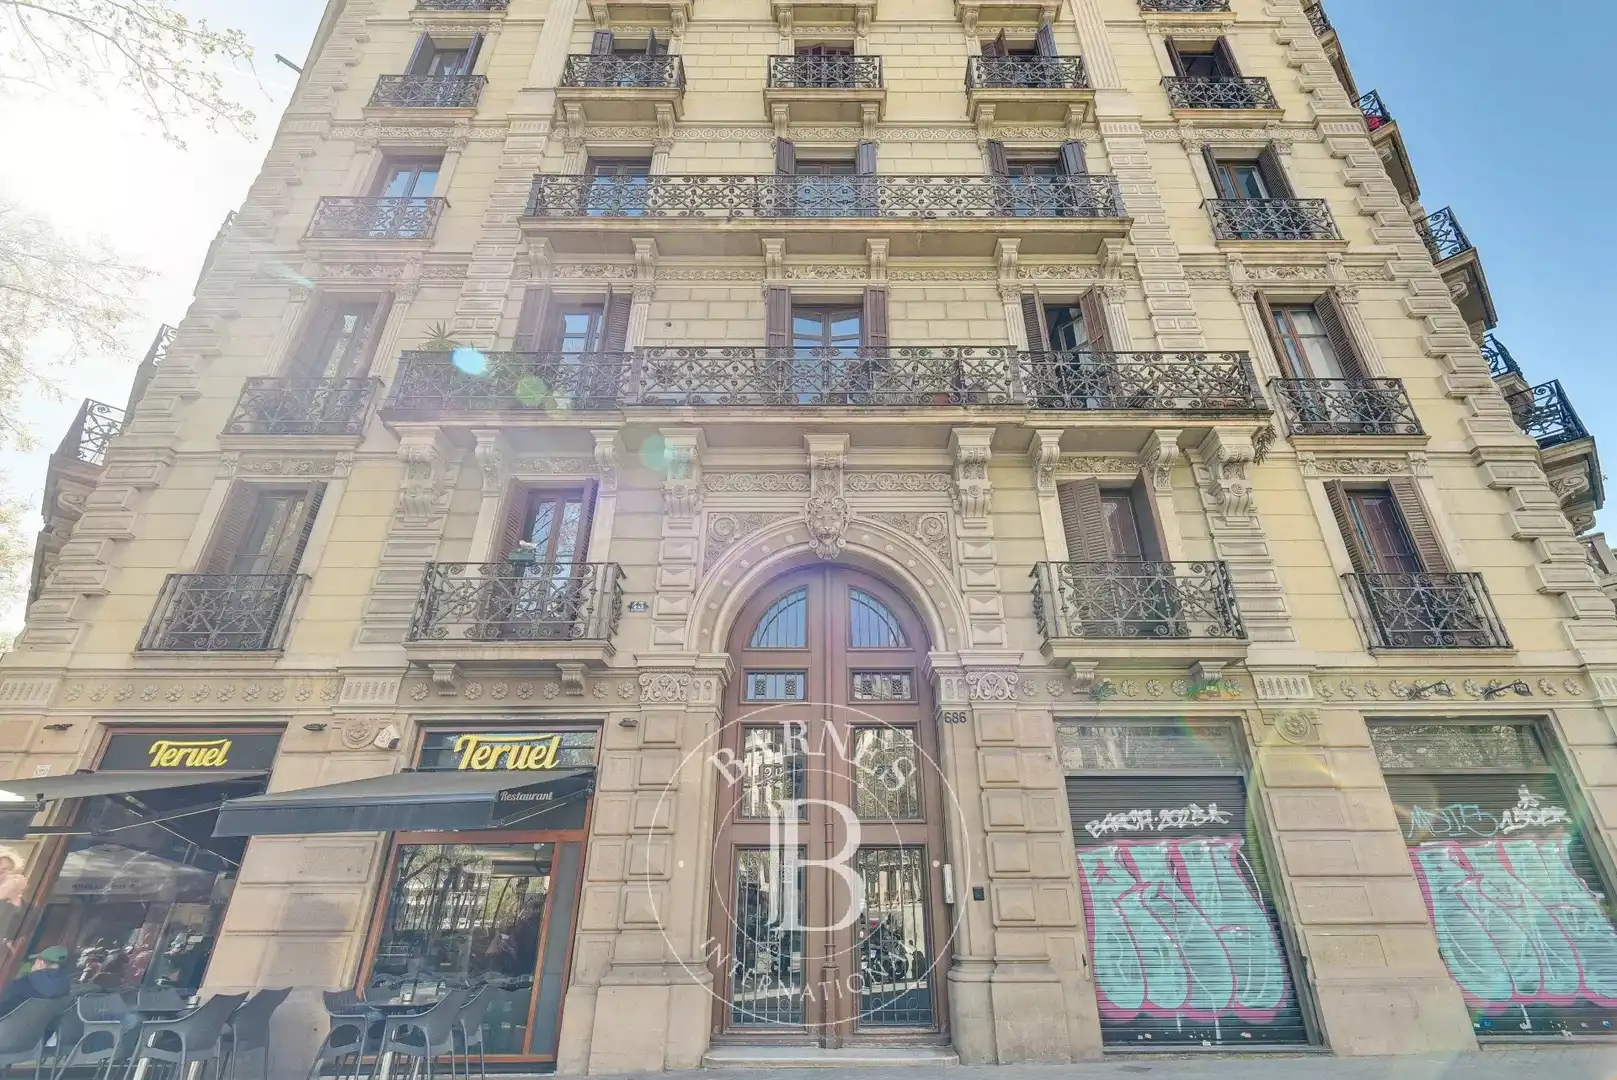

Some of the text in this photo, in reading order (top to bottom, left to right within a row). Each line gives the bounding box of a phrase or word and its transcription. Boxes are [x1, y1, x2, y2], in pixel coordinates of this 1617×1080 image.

[944, 712, 967, 723] 686
[148, 739, 232, 767] Teruel
[453, 733, 562, 770] Teruel
[500, 790, 553, 801] Restaurant
